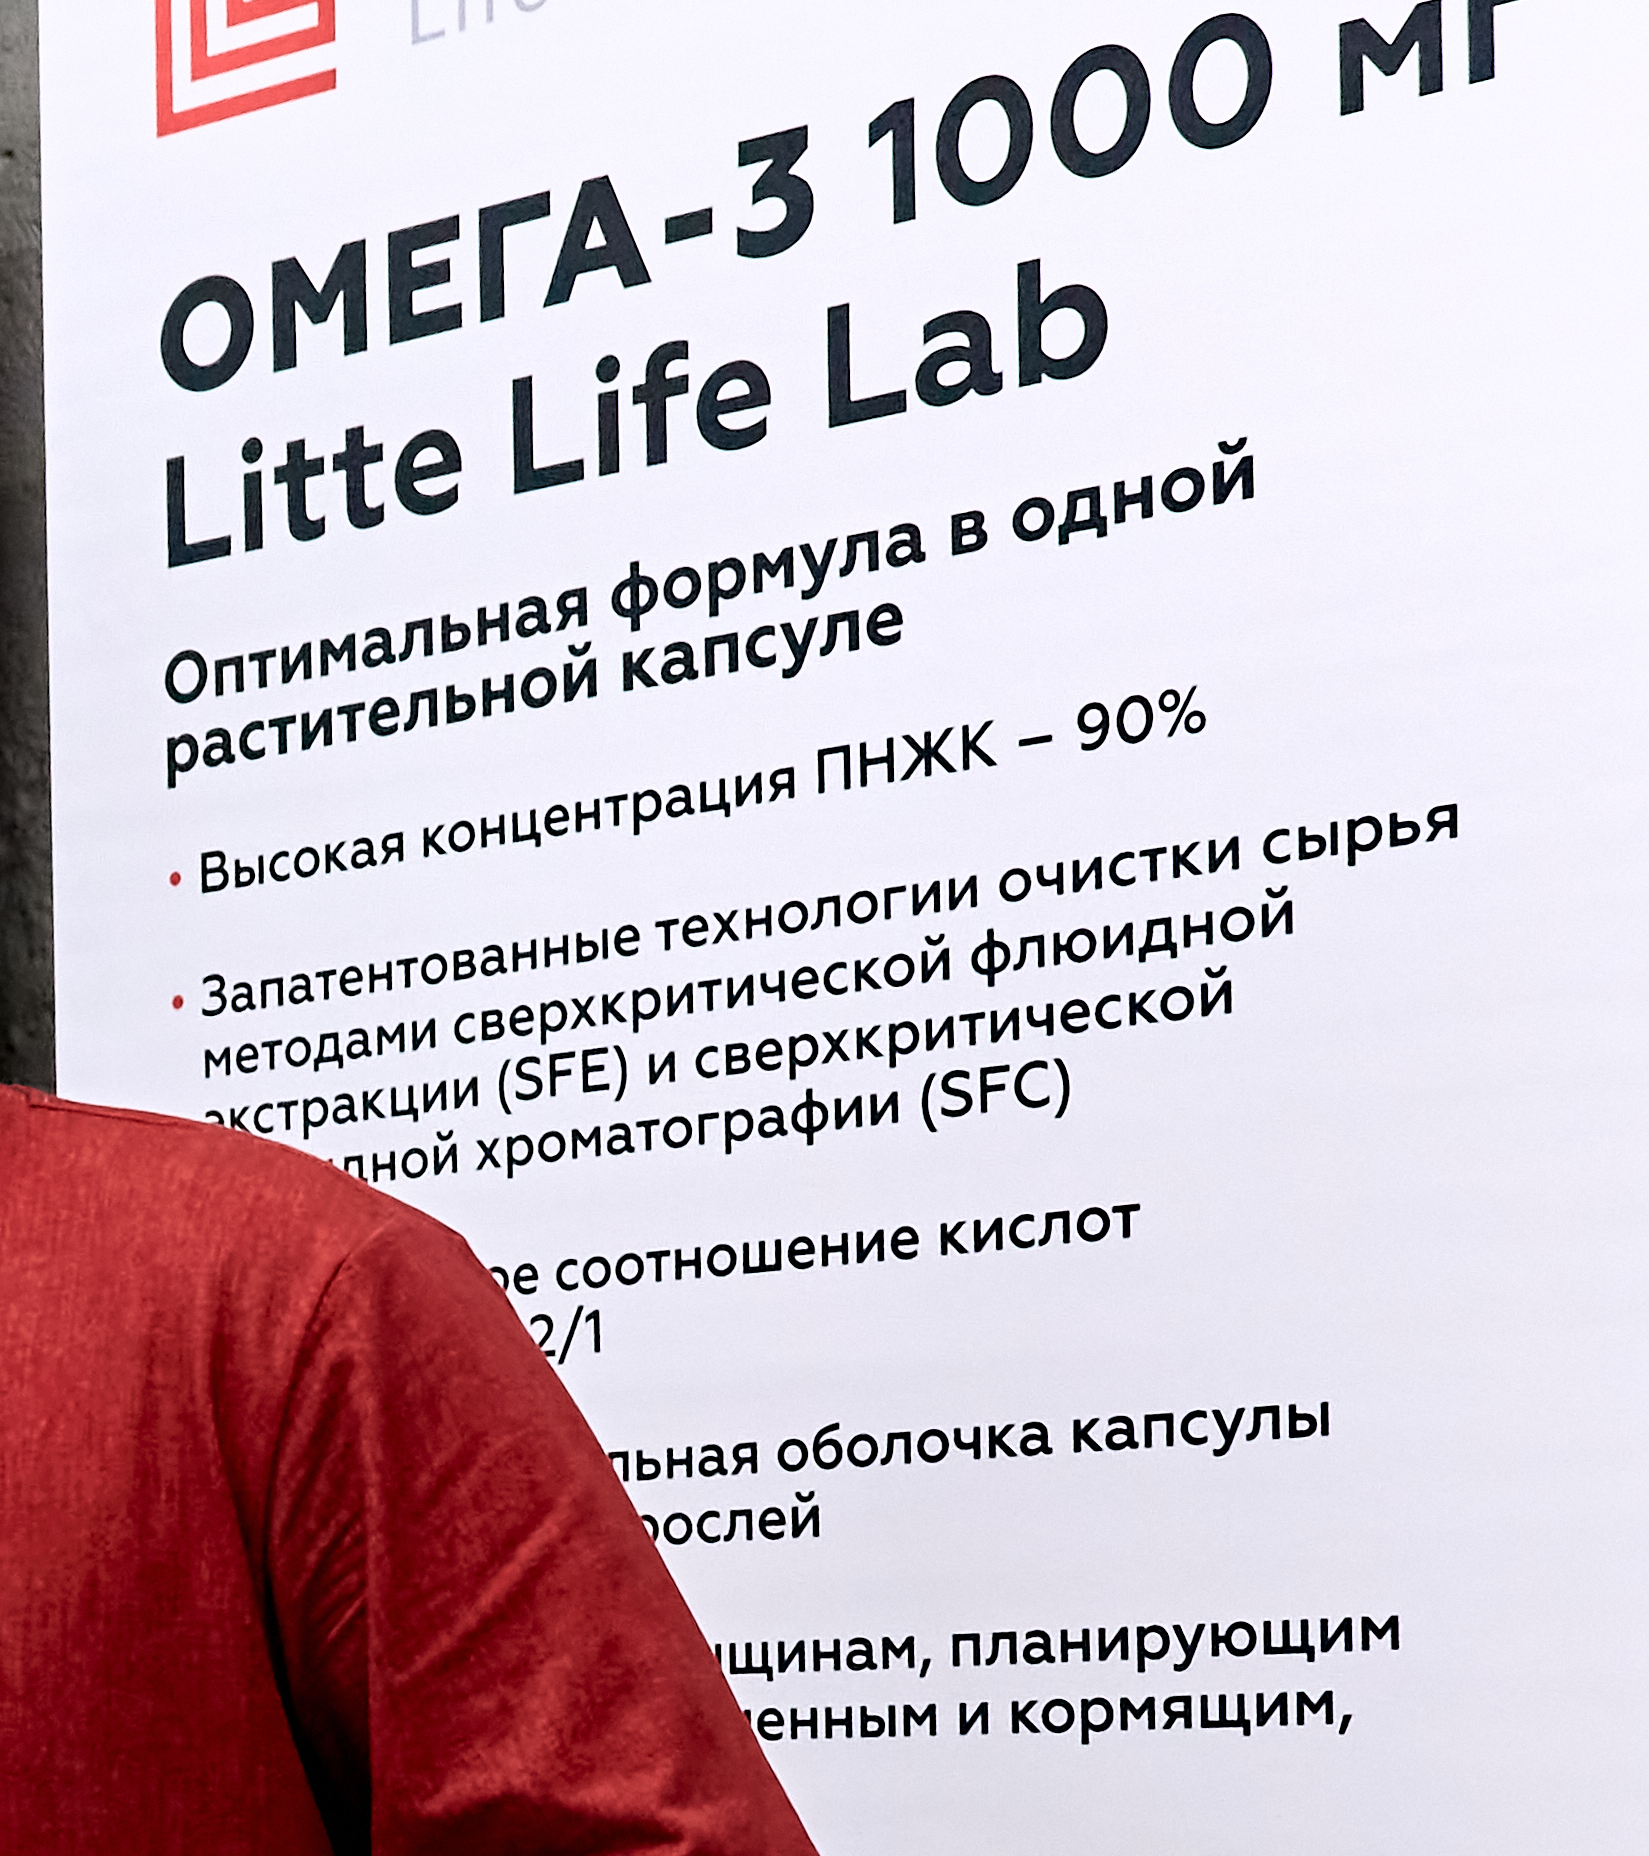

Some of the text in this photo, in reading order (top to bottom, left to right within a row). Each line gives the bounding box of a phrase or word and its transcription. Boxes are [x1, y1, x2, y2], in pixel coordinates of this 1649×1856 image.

[160, 124, 814, 392] ОМЕГА-3
[868, 12, 1273, 225] 1000
[166, 258, 1109, 569] Litte Life Lab
[164, 436, 1255, 704] Оптимальная формула в одной
[166, 602, 904, 789] растительной капсуле
[200, 831, 404, 894] Высокая
[423, 766, 795, 858] концентрация
[817, 719, 998, 794] ПНЖК
[1077, 685, 1207, 752] 90%
[201, 803, 1458, 1017] Запатентованные технологии очистки сырья
[204, 885, 1294, 1079] методами сверхкритической флюидной
[476, 1057, 1070, 1179] хроматографии (SFC)
[498, 1044, 628, 1115] (SFE)
[648, 1051, 676, 1085] и
[695, 965, 1232, 1081] сверхкритической
[555, 1203, 1141, 1292] соотношение кислот
[777, 1421, 1054, 1473] оболочка
[1072, 1401, 1330, 1458] капсулы
[744, 1690, 1353, 1746] енным и кормящим,
[951, 1615, 1400, 1674] планирующим
